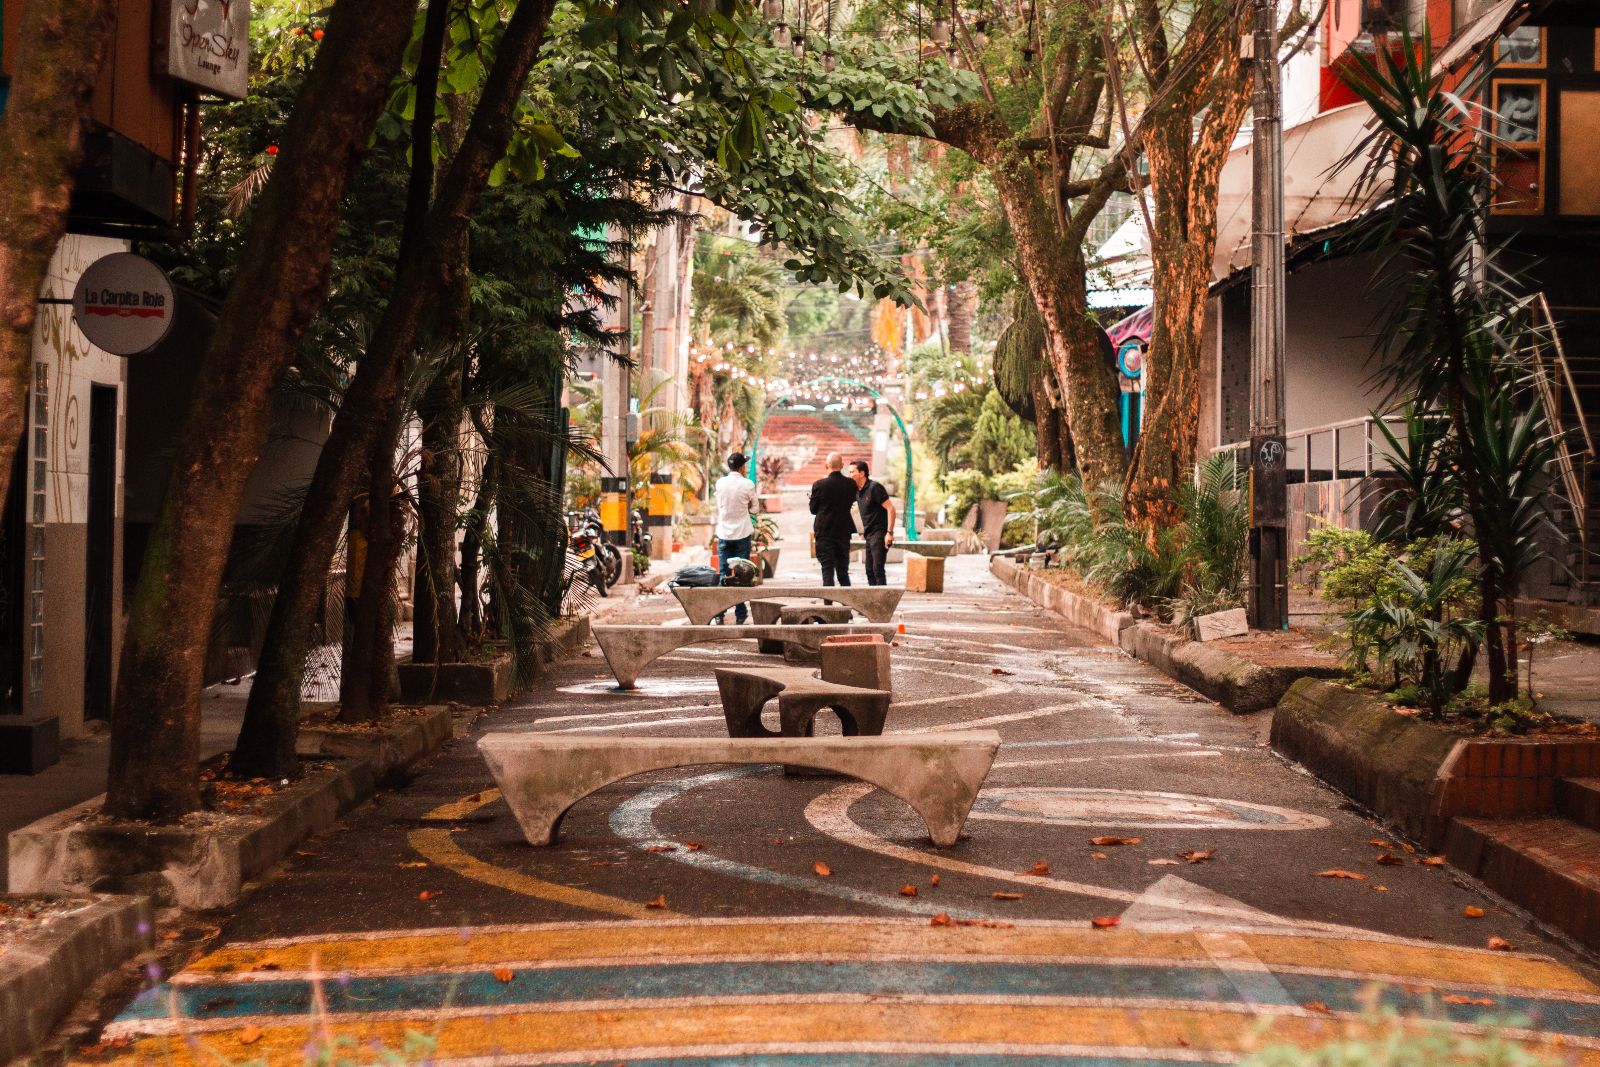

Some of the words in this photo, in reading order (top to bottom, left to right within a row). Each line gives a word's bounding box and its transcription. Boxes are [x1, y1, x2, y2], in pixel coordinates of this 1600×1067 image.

[197, 56, 222, 75] Lounge
[85, 288, 98, 304] La
[101, 288, 140, 306] Carpita
[142, 291, 165, 308] Roja
